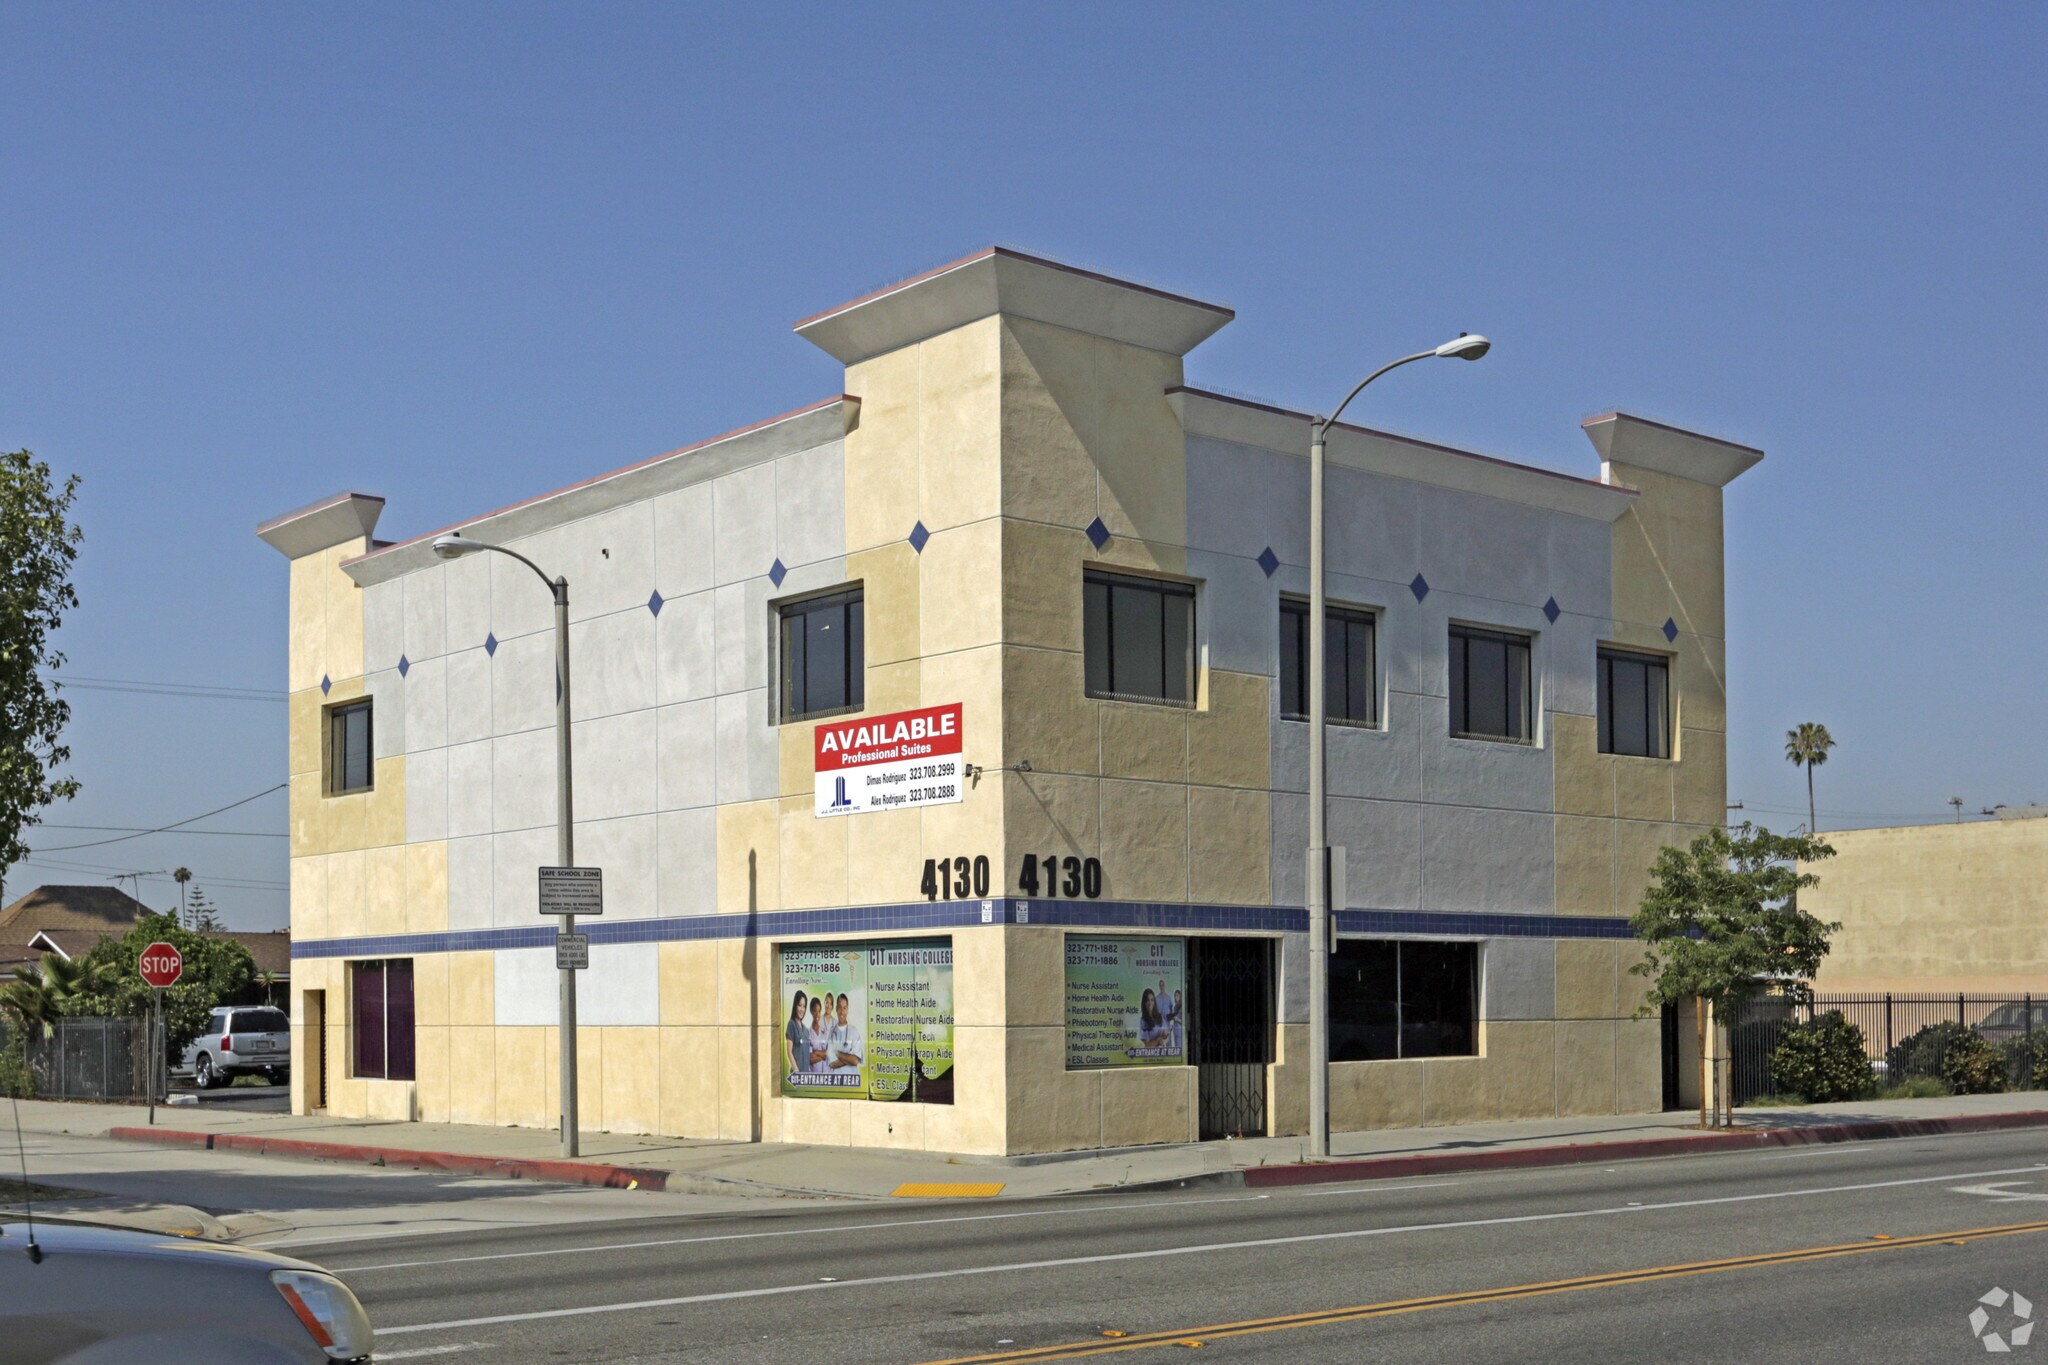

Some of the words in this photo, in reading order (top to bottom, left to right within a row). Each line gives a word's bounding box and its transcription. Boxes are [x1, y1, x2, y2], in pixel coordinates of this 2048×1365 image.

[821, 713, 955, 753] AVAILABLE
[842, 745, 898, 764] Professional
[901, 743, 932, 757] Suites
[867, 775, 882, 786] Dimas
[882, 772, 906, 784] Rodriguez
[909, 762, 955, 780] 323.708.2999
[871, 796, 882, 806] Alex
[882, 793, 906, 806] Rodriguez
[909, 784, 955, 802] 323.708.2888
[921, 855, 990, 902] 4130
[1019, 854, 1102, 899] 4130
[785, 950, 840, 960] 323-771-1882
[1150, 944, 1164, 957] CIT
[870, 948, 885, 966] CIT
[888, 951, 921, 965] NURSING
[922, 950, 953, 965] COLLEGE
[142, 957, 179, 973] STOP
[785, 963, 841, 974] 323-771-1886
[1136, 959, 1157, 967] NURSING
[1159, 959, 1179, 967] COLLEGE
[875, 982, 895, 991] Nurse
[897, 982, 929, 991] Assistant
[1071, 982, 1090, 990] Nurse
[1091, 982, 1118, 990] Assistant
[875, 998, 895, 1008] Home
[897, 998, 918, 1008] Health
[920, 998, 936, 1008] Aide
[1091, 994, 1109, 1002] Health
[1111, 994, 1124, 1002] Aide
[1072, 1007, 1105, 1015] Restorative
[1107, 1006, 1124, 1014] Nurse
[1125, 1006, 1139, 1014] Aide
[876, 1014, 913, 1025] Restorative
[916, 1015, 936, 1025] Nurse
[939, 1015, 954, 1024] Aide
[1072, 1019, 1107, 1028] Phlebotomy
[1109, 1018, 1124, 1027] Tech
[876, 1031, 915, 1042] Phlebotomy
[918, 1032, 935, 1041] Tech
[1072, 1031, 1097, 1041] Physical
[1099, 1031, 1122, 1040] Therapy
[1124, 1030, 1137, 1039] Aide
[876, 1047, 905, 1058] Physical
[937, 1049, 952, 1058] Aide
[1072, 1044, 1095, 1052] Medical
[1096, 1043, 1124, 1051] Assistant
[1168, 1048, 1180, 1056] REAR
[1072, 1056, 1084, 1064] ESL
[1086, 1056, 1109, 1064] Classes
[877, 1063, 902, 1074] Medical
[904, 1065, 937, 1075] Asstant
[834, 1075, 841, 1085] AT
[843, 1075, 860, 1086] REAR
[877, 1080, 890, 1090] ESL
